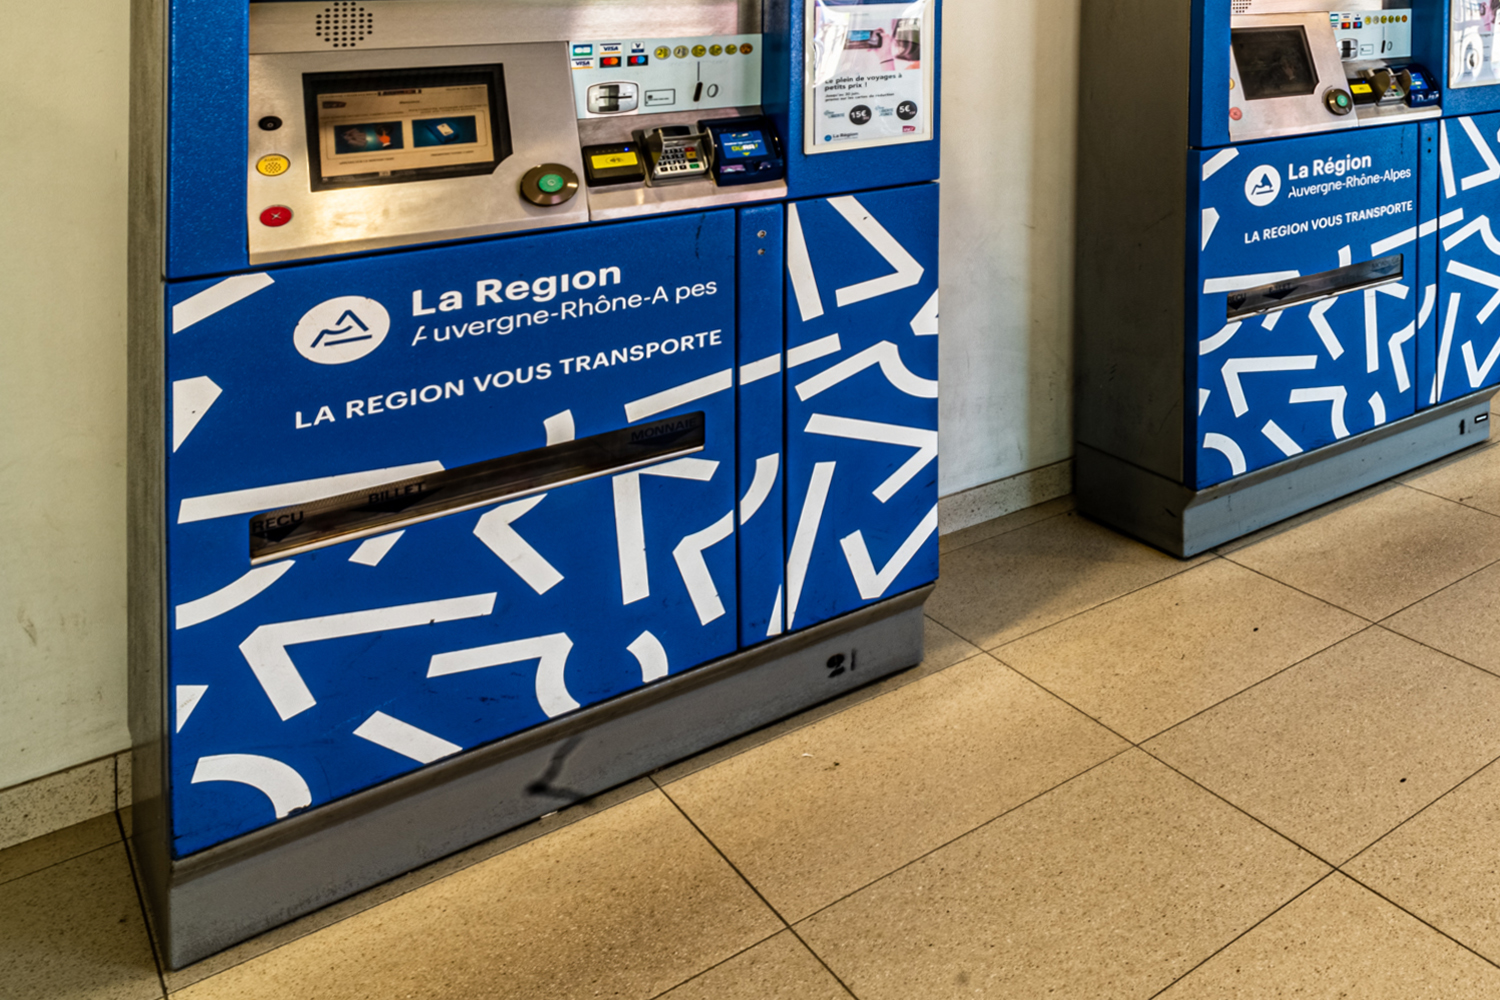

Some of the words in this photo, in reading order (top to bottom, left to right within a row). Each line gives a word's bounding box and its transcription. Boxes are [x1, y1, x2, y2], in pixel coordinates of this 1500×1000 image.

[824, 83, 846, 92] petits
[836, 76, 854, 85] plein
[851, 110, 867, 119] 15€
[899, 104, 910, 113] 5€
[1288, 163, 1309, 180] La
[1312, 154, 1372, 178] Région
[1288, 168, 1412, 199] Auvergne-Rhône-Alpes
[1244, 231, 1260, 245] LA
[1263, 222, 1309, 241] REGION
[1311, 214, 1343, 231] VOUS
[1345, 200, 1413, 223] TRANSPORTE
[412, 288, 463, 317] La
[295, 406, 336, 430] LA
[346, 378, 465, 420] REGION
[473, 362, 552, 392] VOUS
[558, 328, 723, 376] TRANSPORTE
[630, 416, 698, 442] MONNAIE
[368, 481, 427, 506] BILLET
